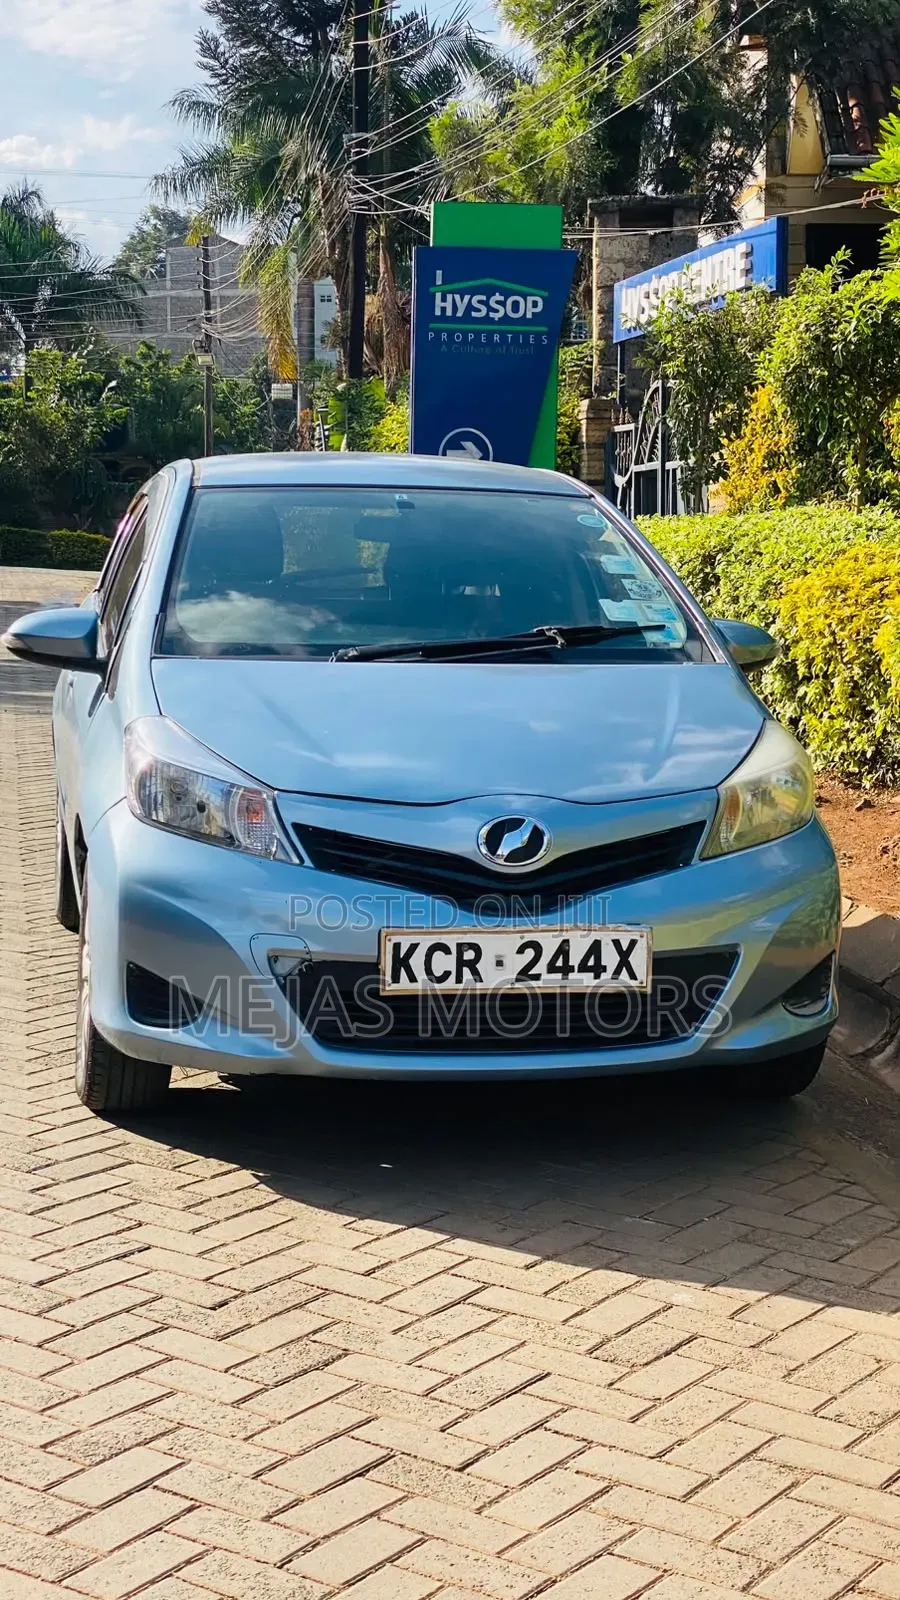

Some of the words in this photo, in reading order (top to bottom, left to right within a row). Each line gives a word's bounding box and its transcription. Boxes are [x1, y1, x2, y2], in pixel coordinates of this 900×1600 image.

[434, 291, 544, 321] HYS$OP
[428, 332, 548, 345] PROPERTIES
[391, 941, 484, 984] KCR
[515, 938, 639, 982] 244X
